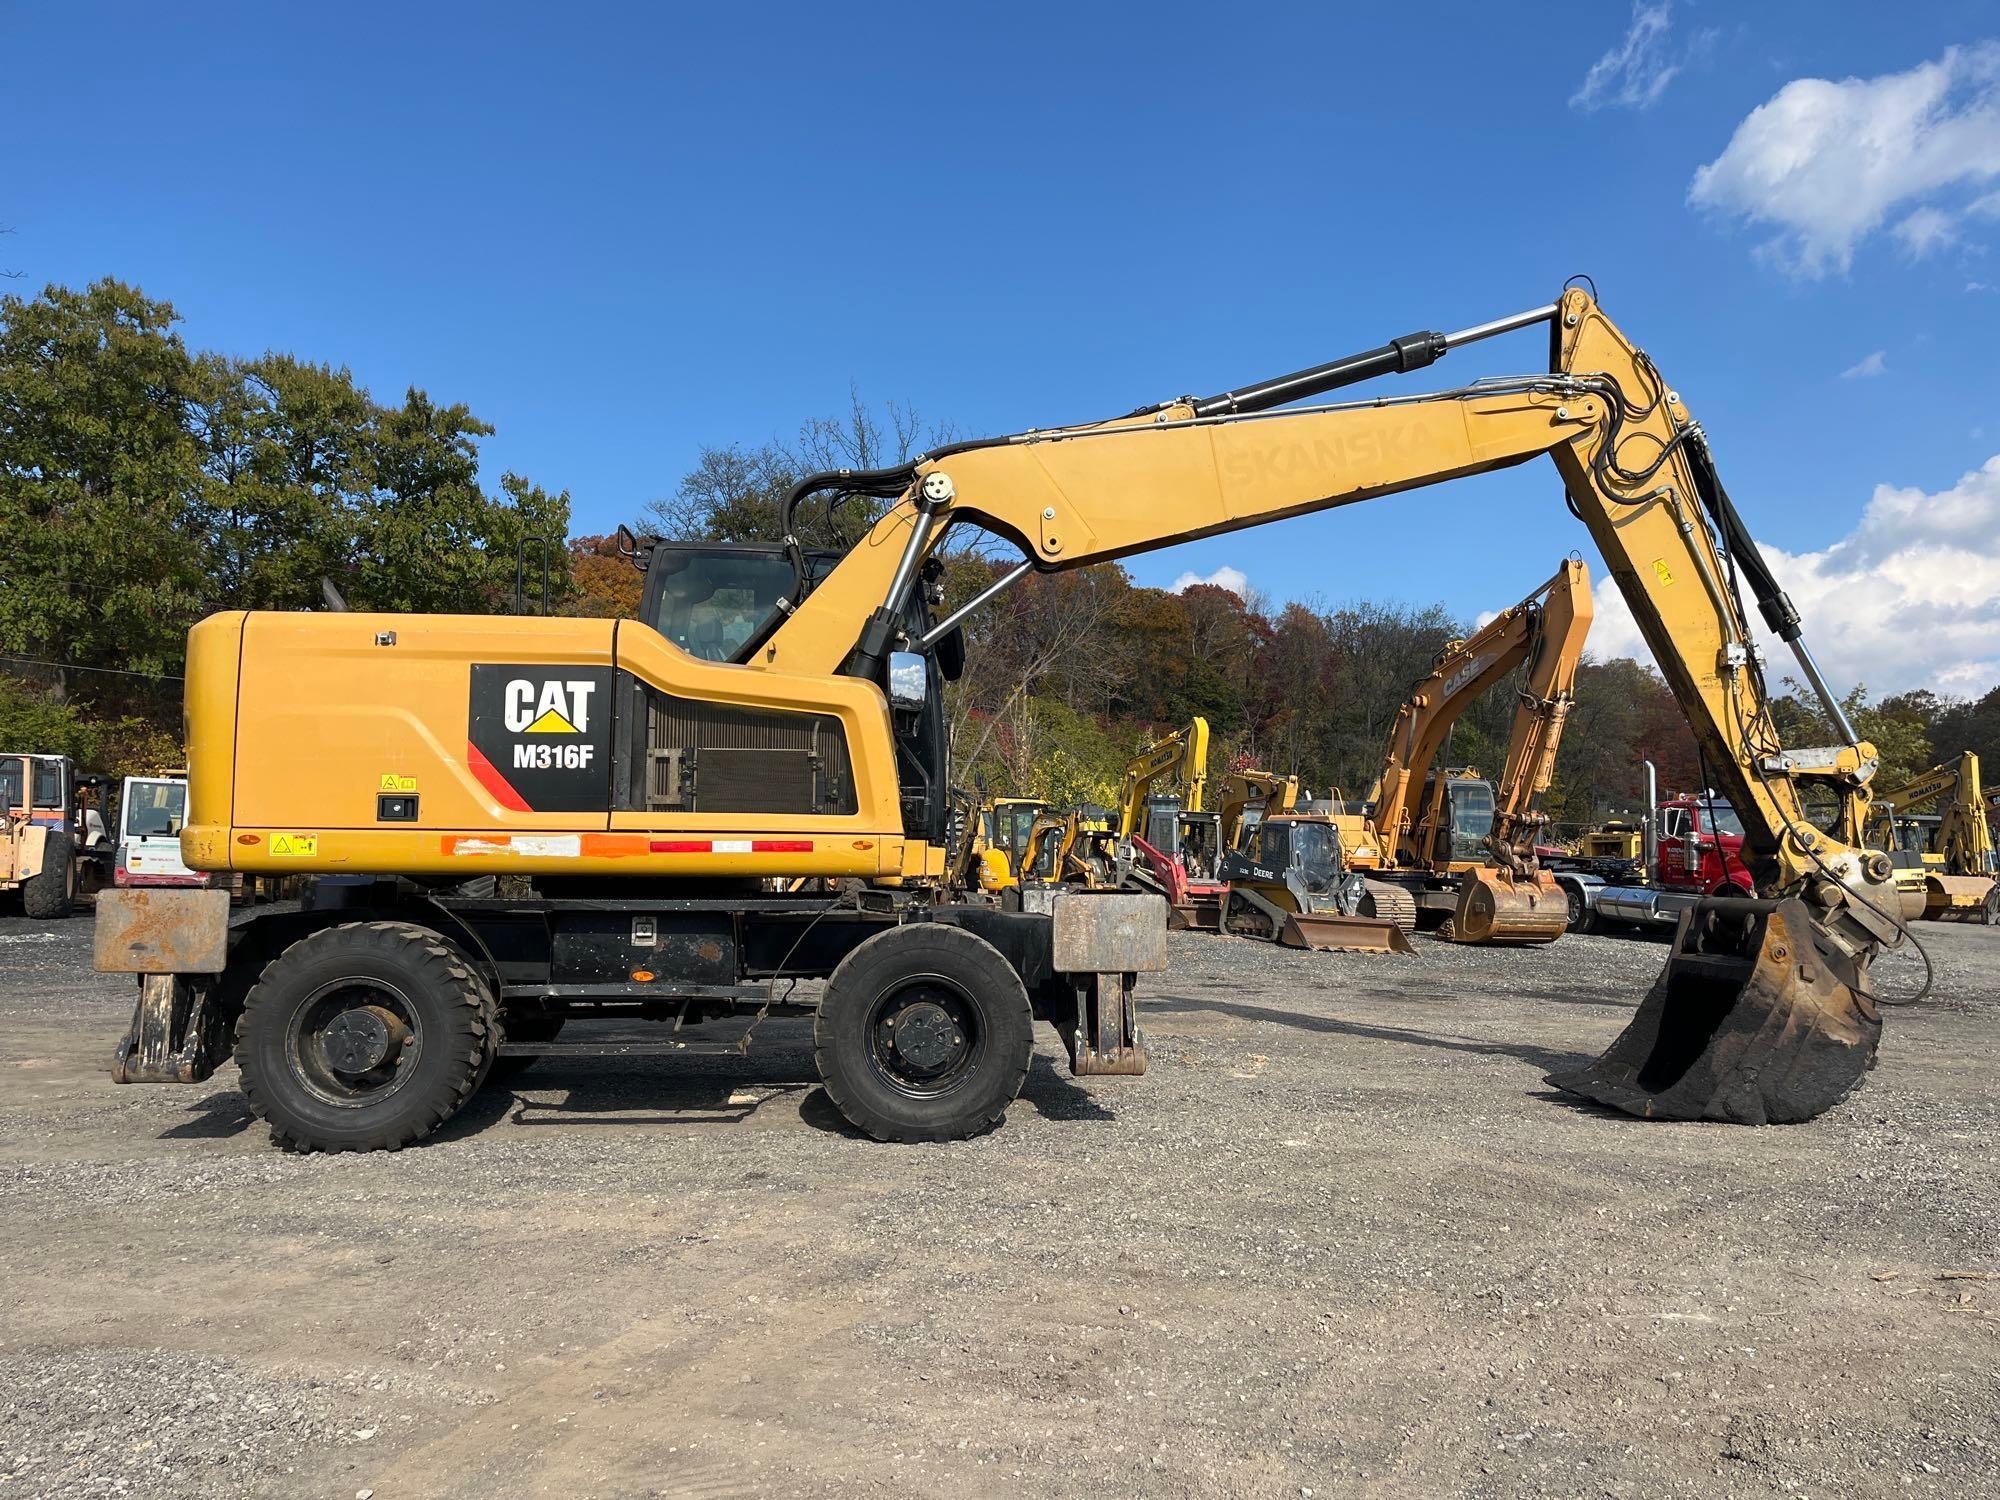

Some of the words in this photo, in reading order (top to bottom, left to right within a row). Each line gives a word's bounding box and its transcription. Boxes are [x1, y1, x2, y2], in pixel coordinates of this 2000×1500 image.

[1224, 421, 1436, 485] SKANSKA
[504, 679, 595, 733] CAT
[513, 744, 594, 769] M316F
[1909, 782, 1942, 799] KOMATSU
[1253, 866, 1274, 879] DEERE
